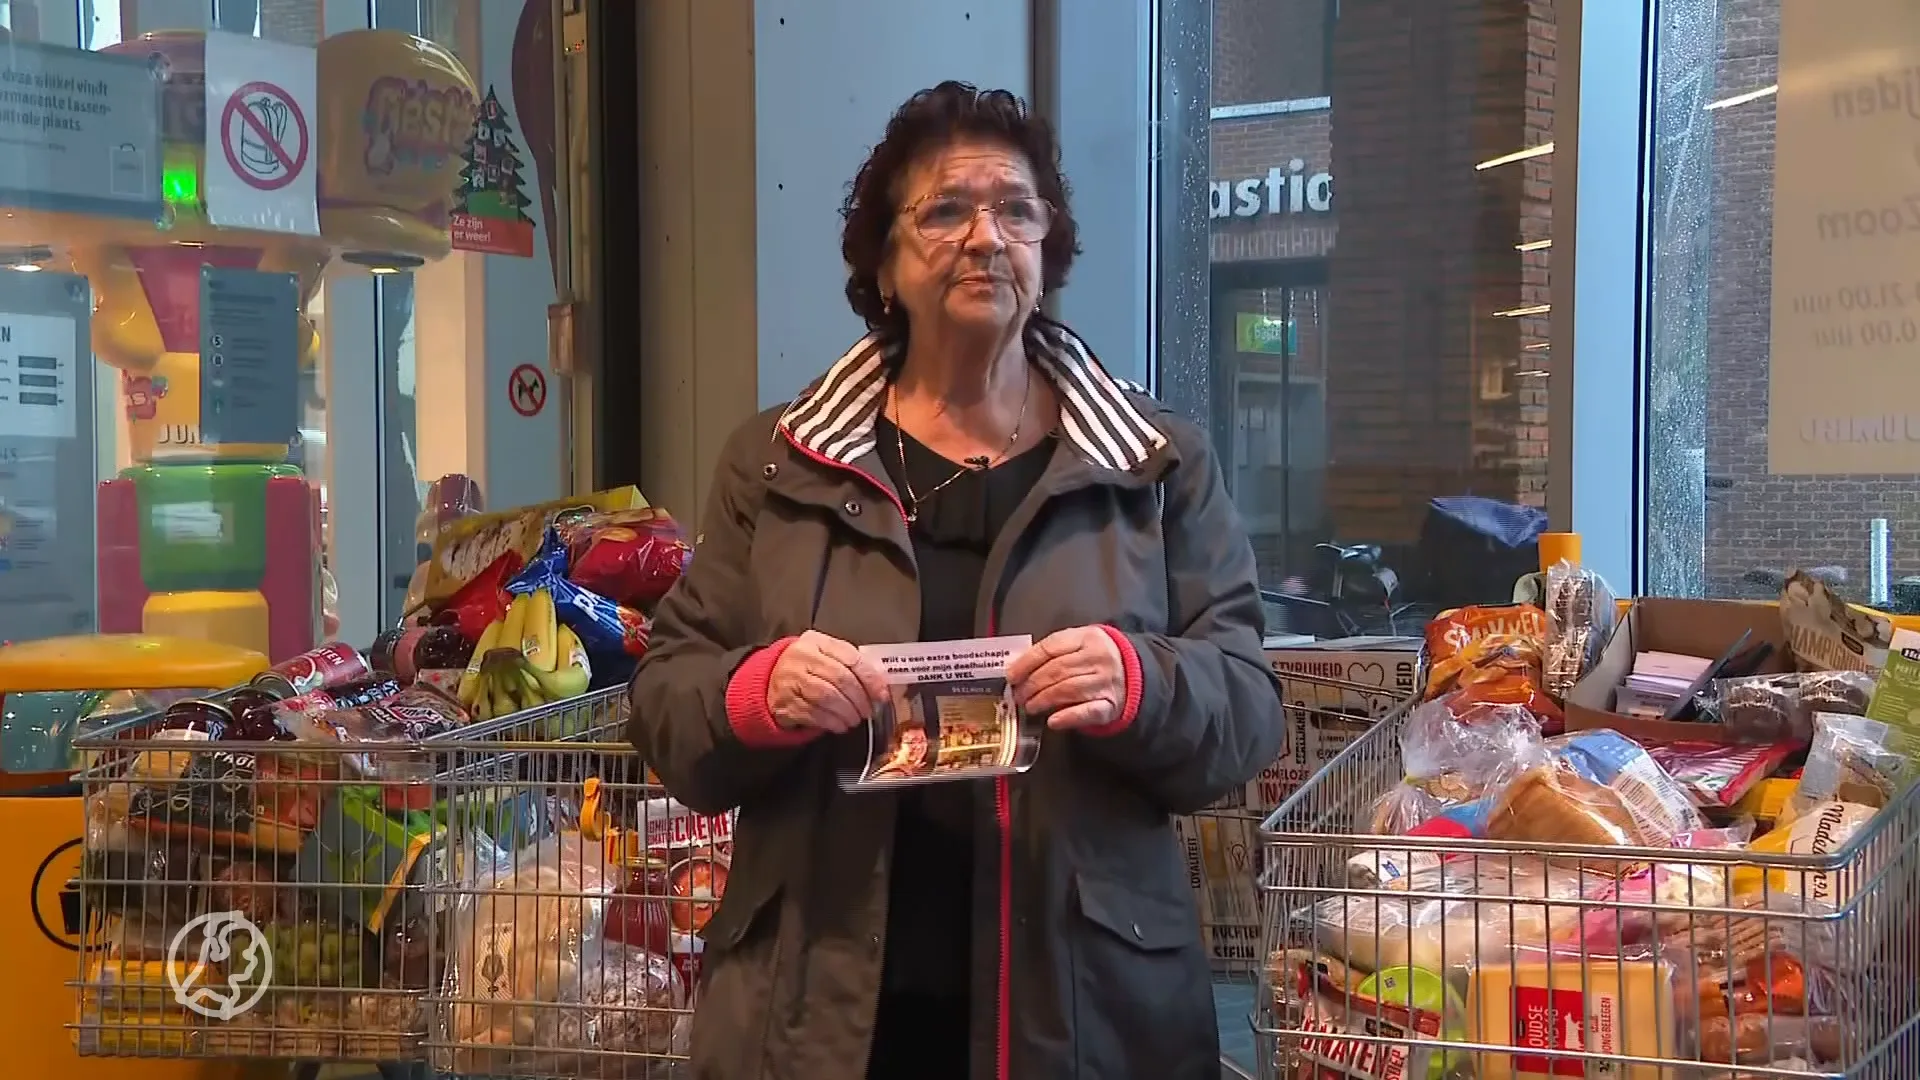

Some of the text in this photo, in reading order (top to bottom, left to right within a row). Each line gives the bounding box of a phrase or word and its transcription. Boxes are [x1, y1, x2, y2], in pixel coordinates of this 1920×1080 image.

[77, 79, 107, 97] vindt
[453, 215, 484, 230] Ze zijn
[453, 231, 492, 243] er weer!
[952, 650, 1010, 660] boodschapje
[911, 665, 930, 673] voor
[932, 663, 952, 671] mijn
[917, 671, 975, 681] DANK U WEL
[1528, 1004, 1544, 1048] OUDSE
